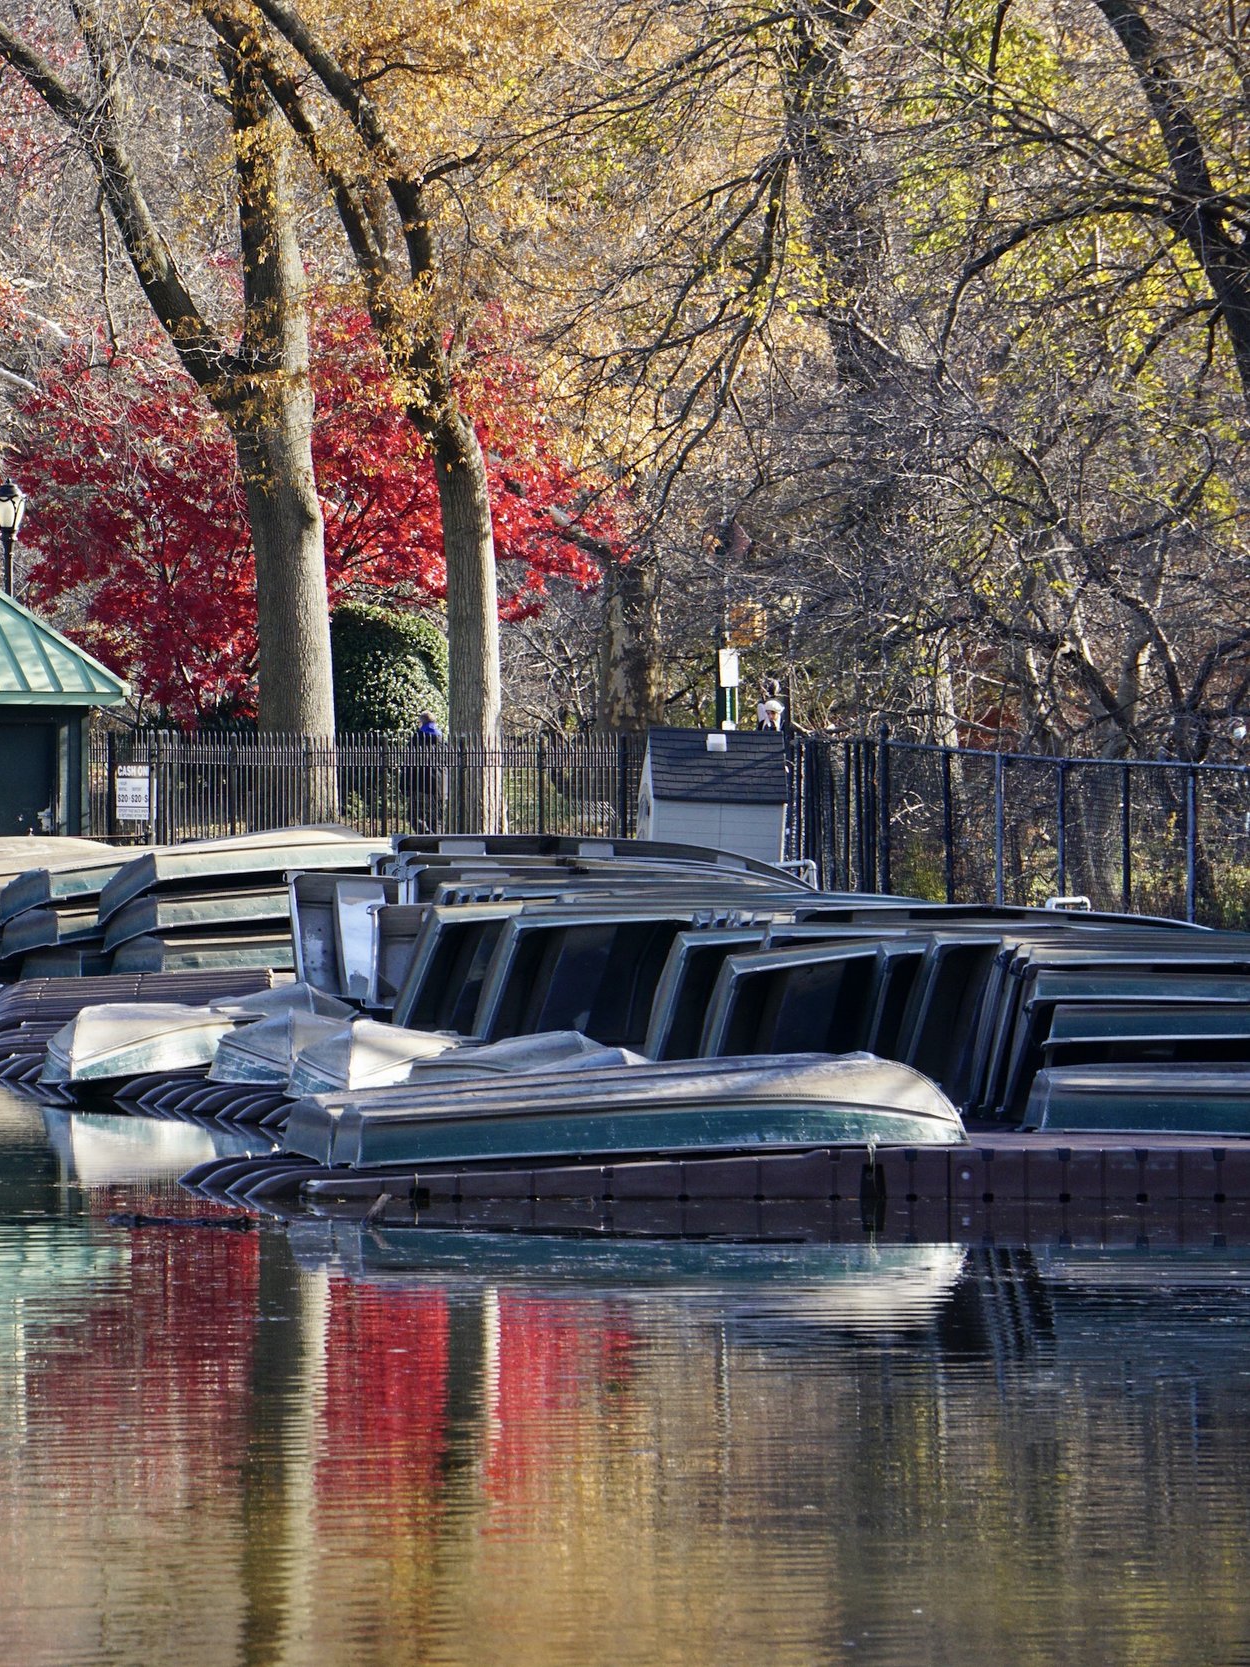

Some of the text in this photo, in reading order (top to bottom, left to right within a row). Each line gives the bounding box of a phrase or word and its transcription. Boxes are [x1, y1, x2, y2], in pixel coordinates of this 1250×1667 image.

[117, 765, 149, 777] CASH ON
[118, 794, 128, 803] $20
[131, 794, 142, 803] $20
